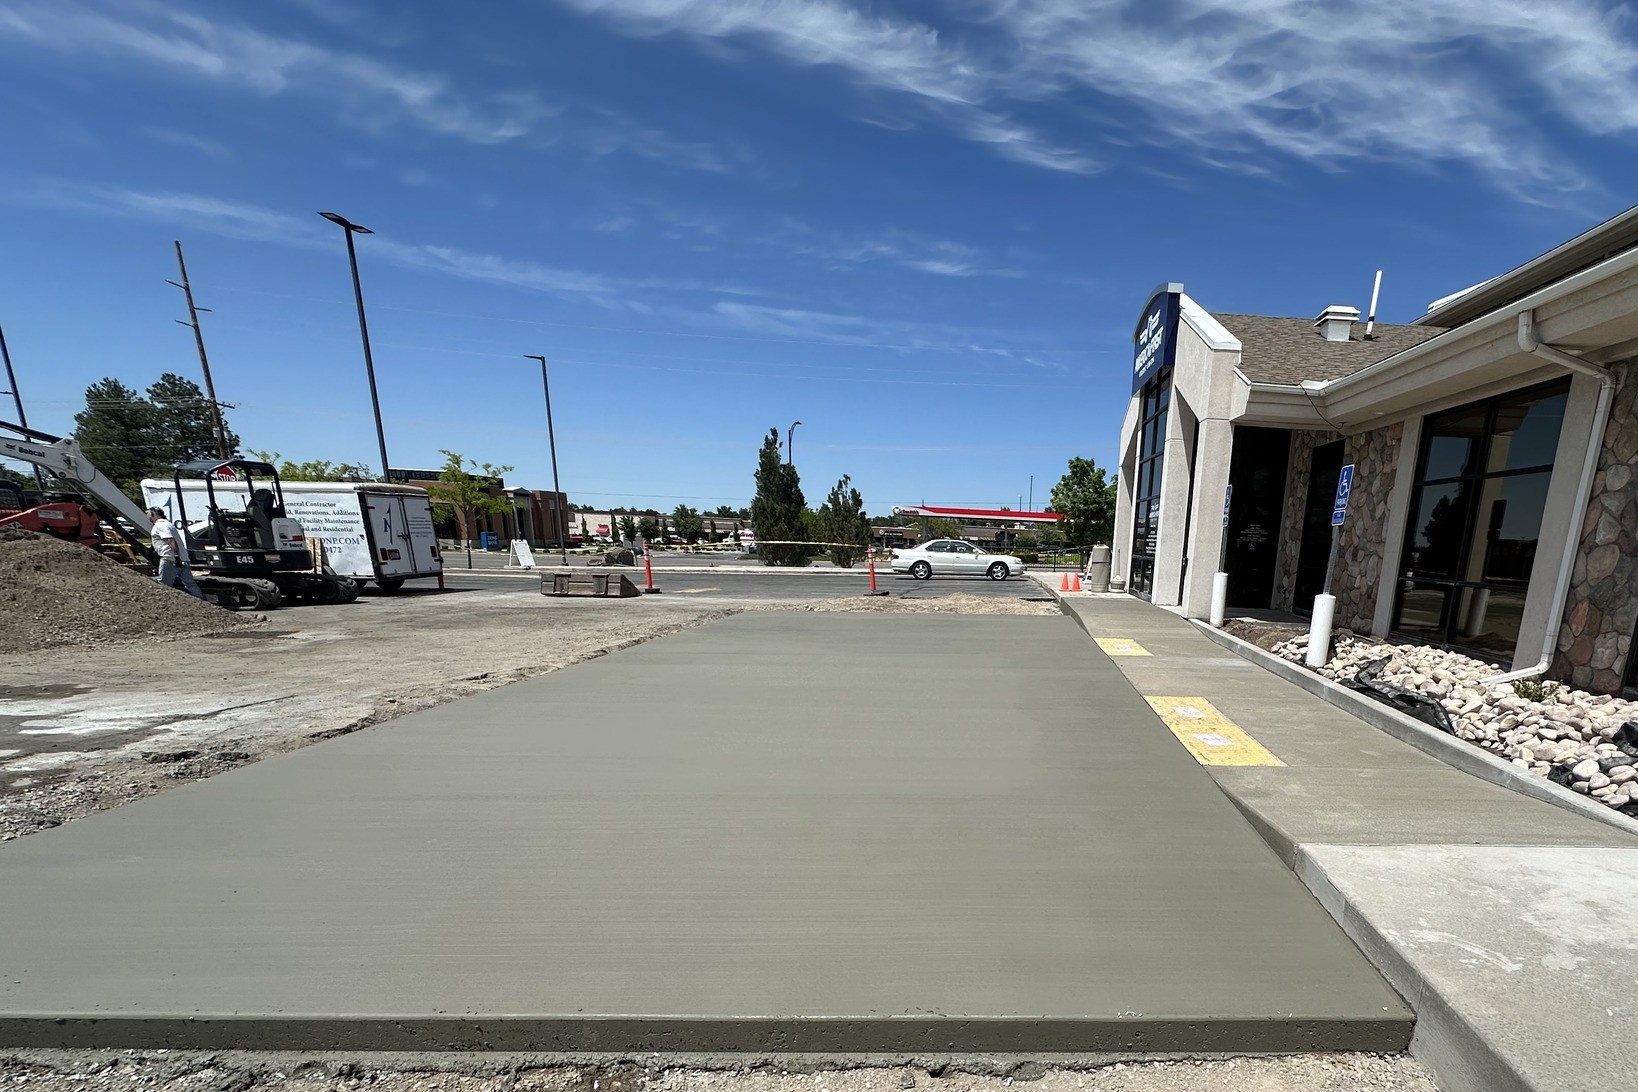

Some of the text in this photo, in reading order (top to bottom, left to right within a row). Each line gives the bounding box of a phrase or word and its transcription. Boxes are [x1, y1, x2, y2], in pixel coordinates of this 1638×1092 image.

[18, 446, 46, 458] Bobcat
[218, 473, 236, 482] STOP
[235, 555, 255, 564] E45
